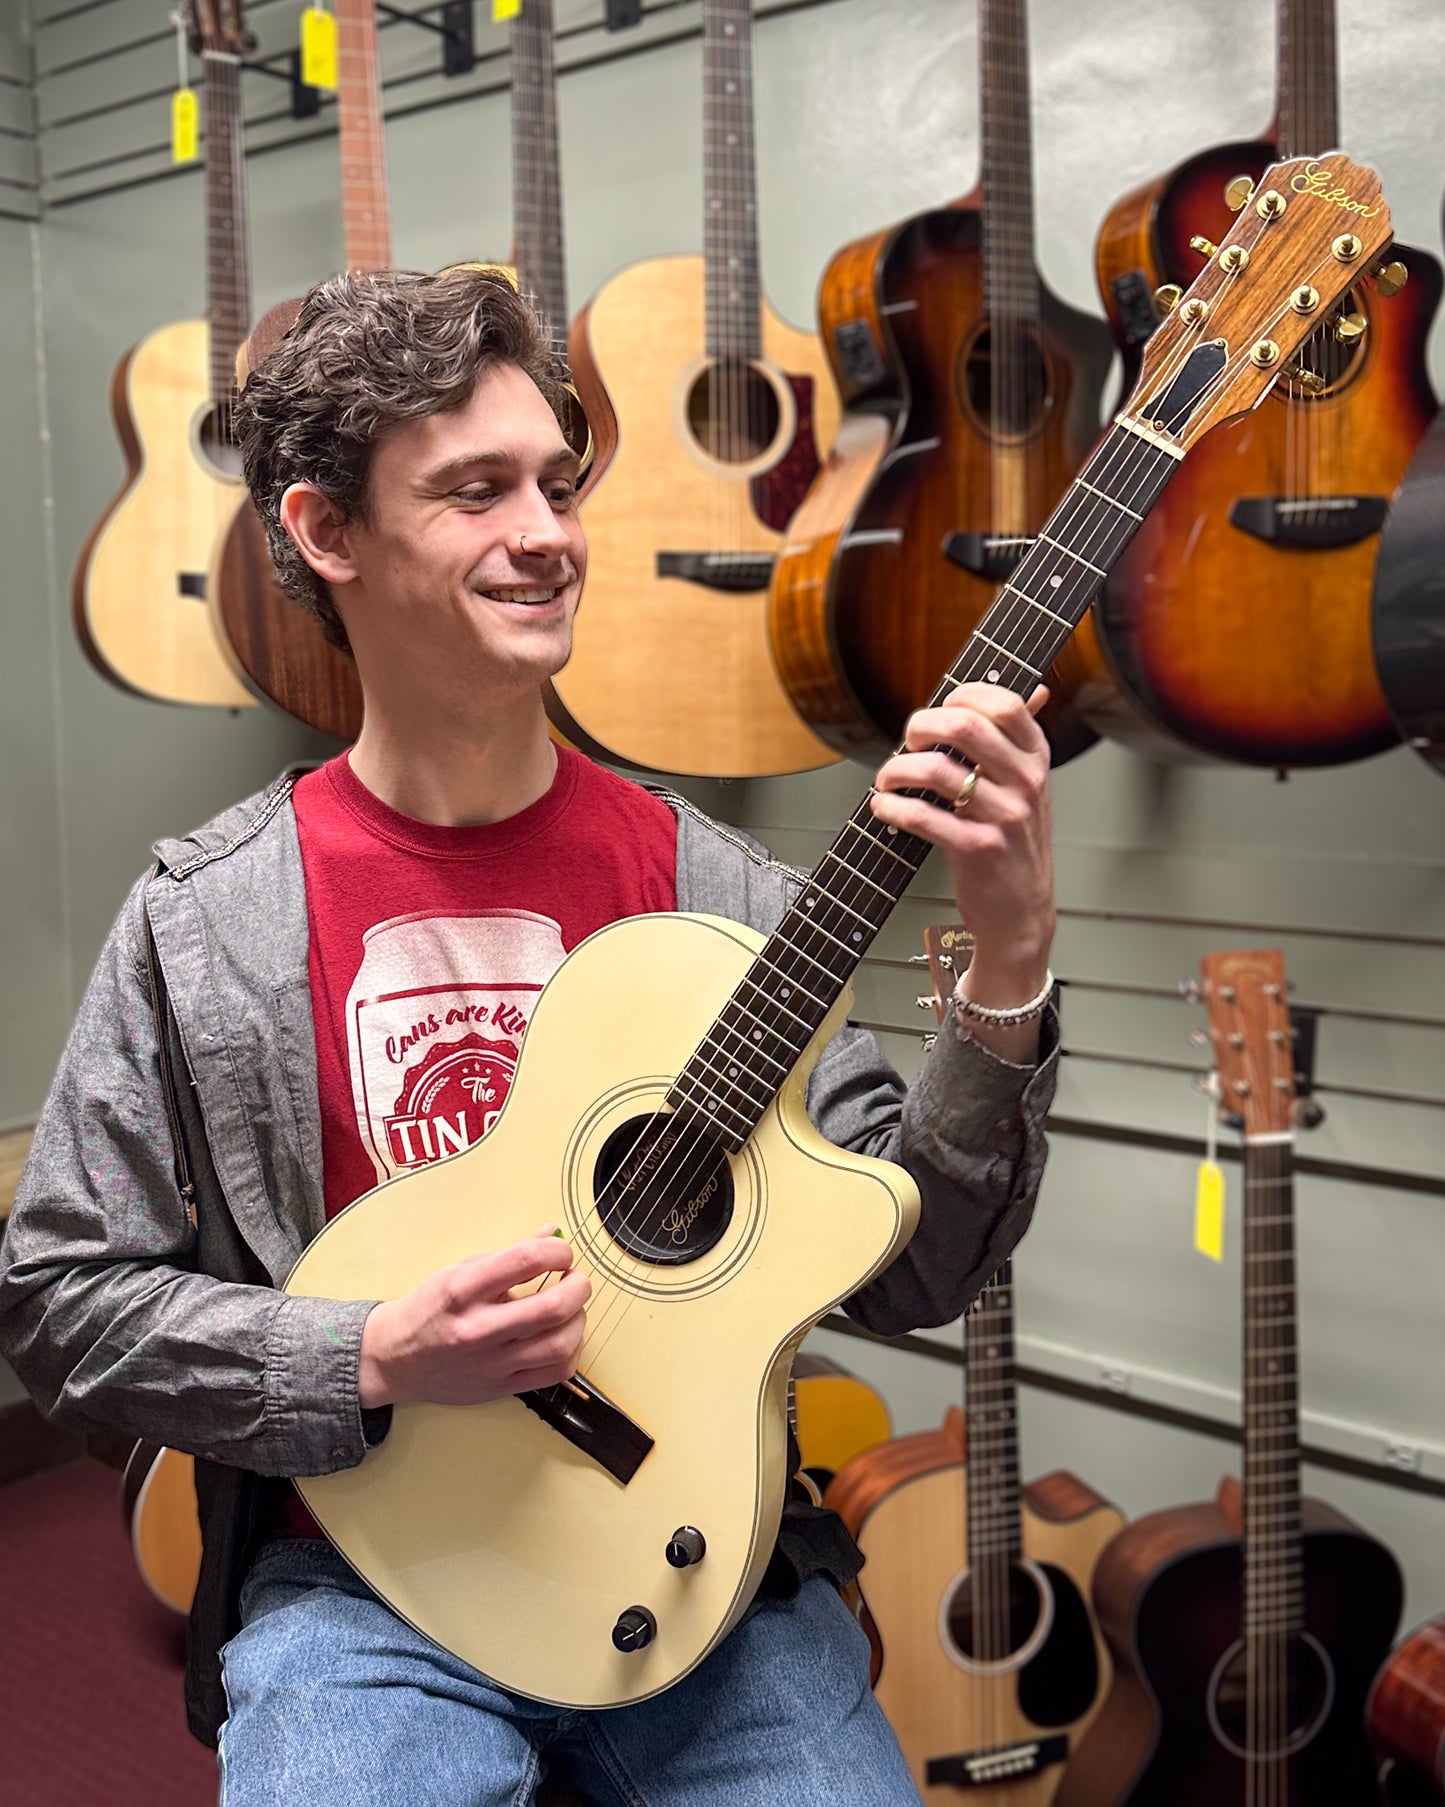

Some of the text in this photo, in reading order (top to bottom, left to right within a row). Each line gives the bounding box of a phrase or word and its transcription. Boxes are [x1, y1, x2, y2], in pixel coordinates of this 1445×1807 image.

[1291, 162, 1380, 217] Gibson
[385, 1003, 442, 1064] Cans
[445, 1005, 489, 1025] are
[460, 1077, 497, 1104] The
[391, 1111, 469, 1162] TIN
[661, 1176, 718, 1245] Gibson
